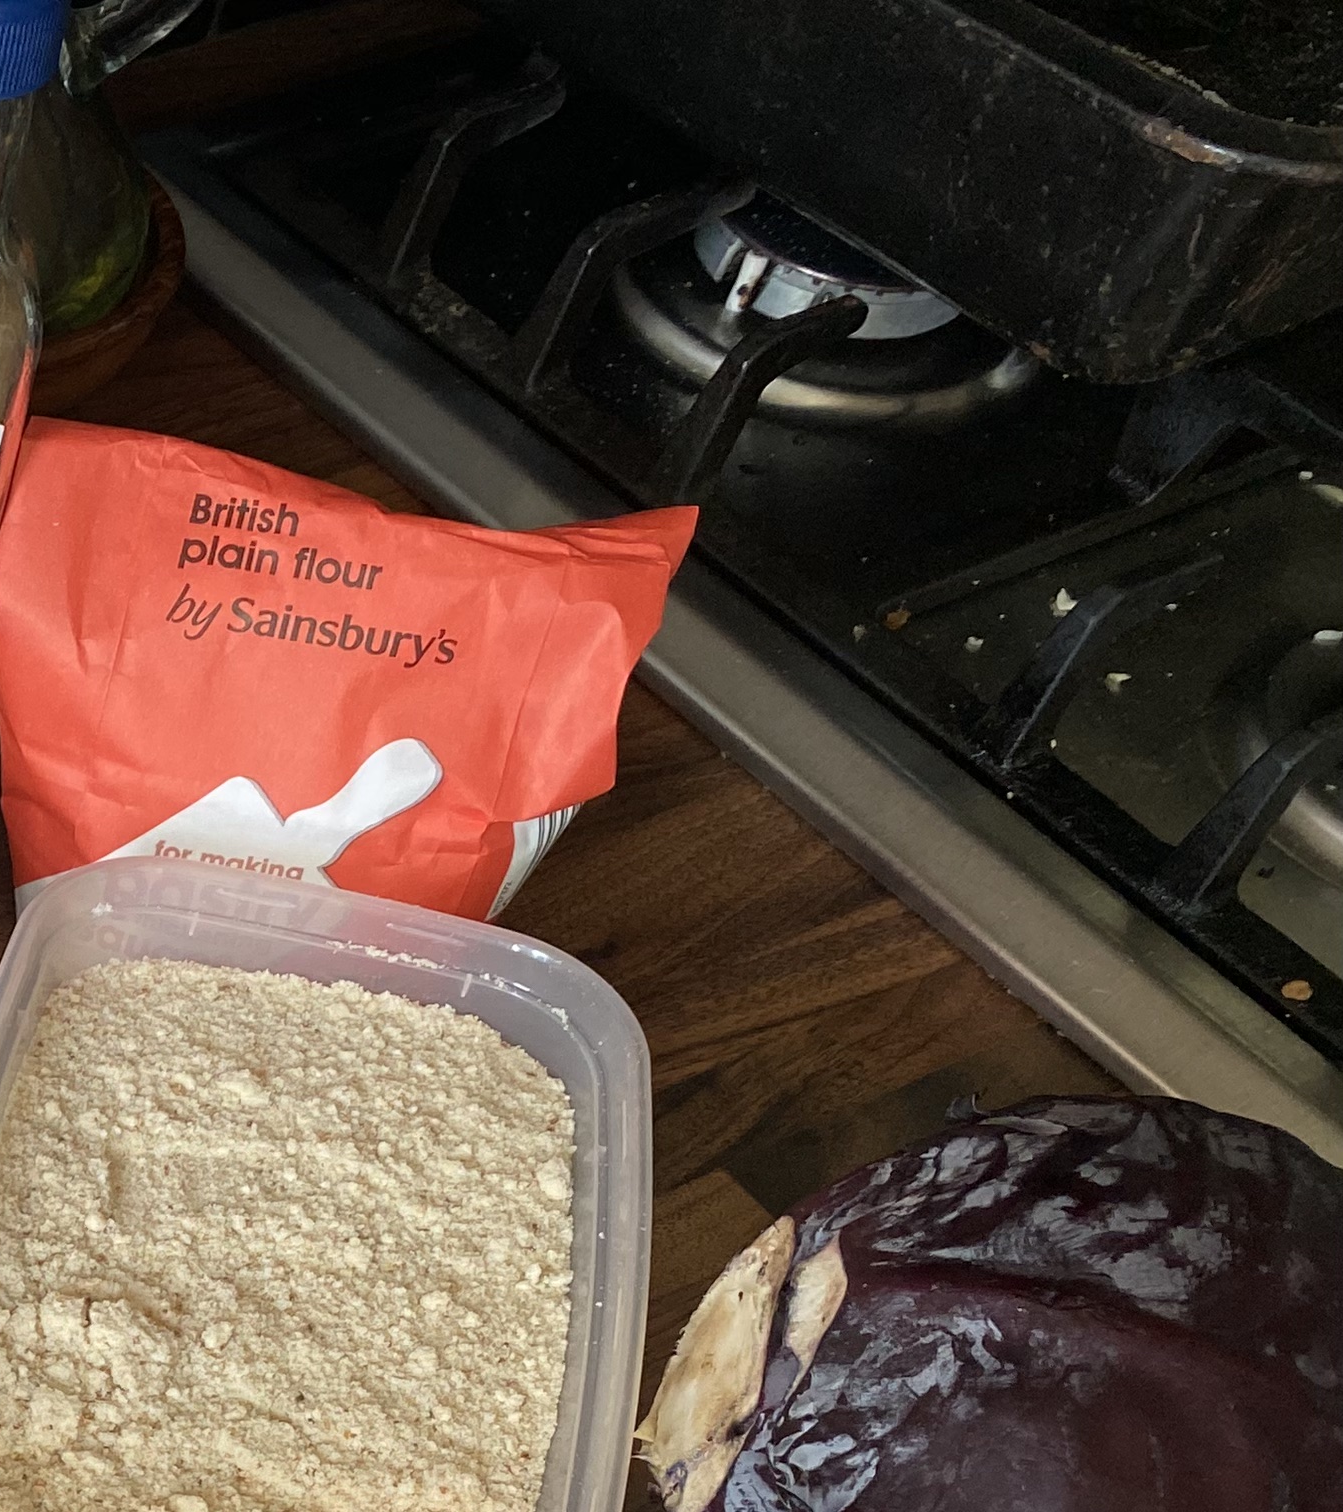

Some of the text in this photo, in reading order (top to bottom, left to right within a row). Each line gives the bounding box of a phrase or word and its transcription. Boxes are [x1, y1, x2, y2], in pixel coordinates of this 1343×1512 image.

[189, 493, 299, 536] British
[177, 535, 383, 590] plain flour
[166, 583, 458, 668] by Sainsbury's
[154, 840, 192, 858] for
